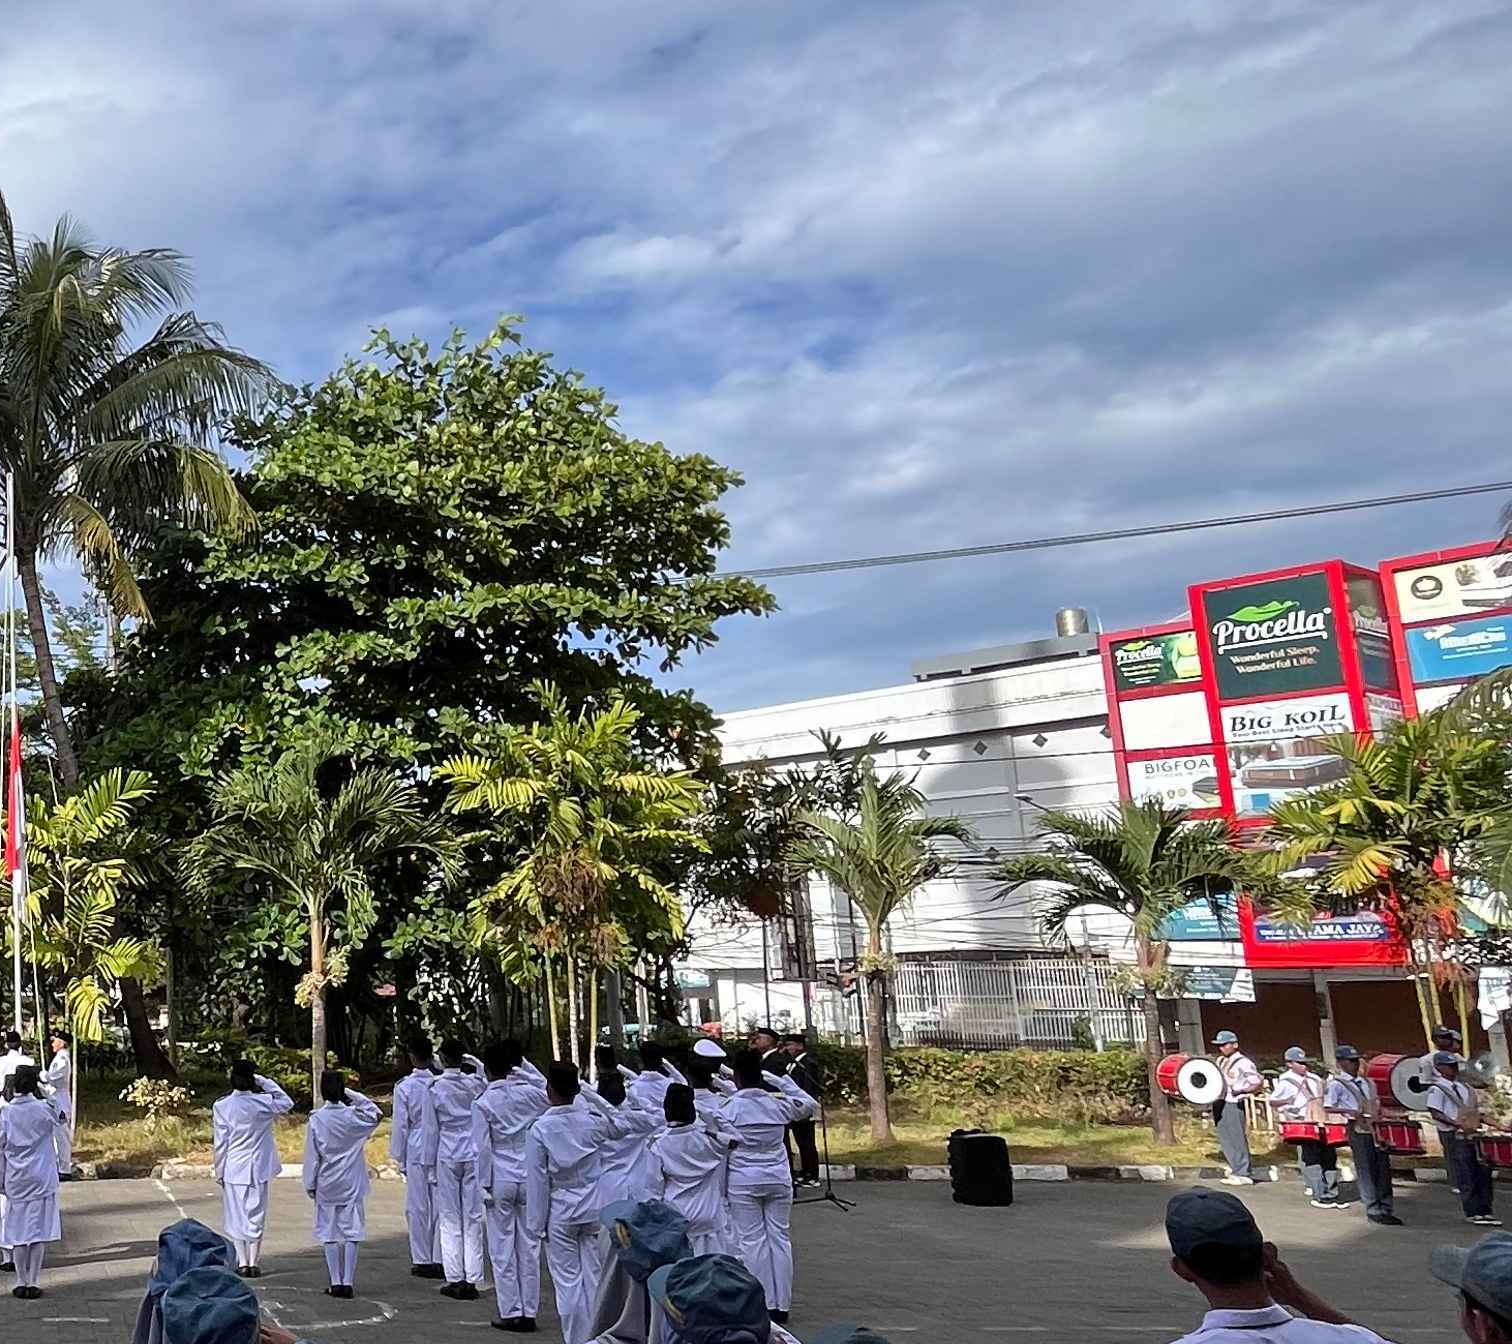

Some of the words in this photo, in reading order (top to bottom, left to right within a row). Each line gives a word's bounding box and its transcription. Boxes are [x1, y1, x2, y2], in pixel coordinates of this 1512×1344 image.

[1212, 610, 1326, 646] Procella
[1230, 647, 1285, 664] Wonderful
[1236, 657, 1291, 674] Wonderful
[1284, 705, 1346, 726] KOIL
[1144, 758, 1216, 774] BIGFOA
